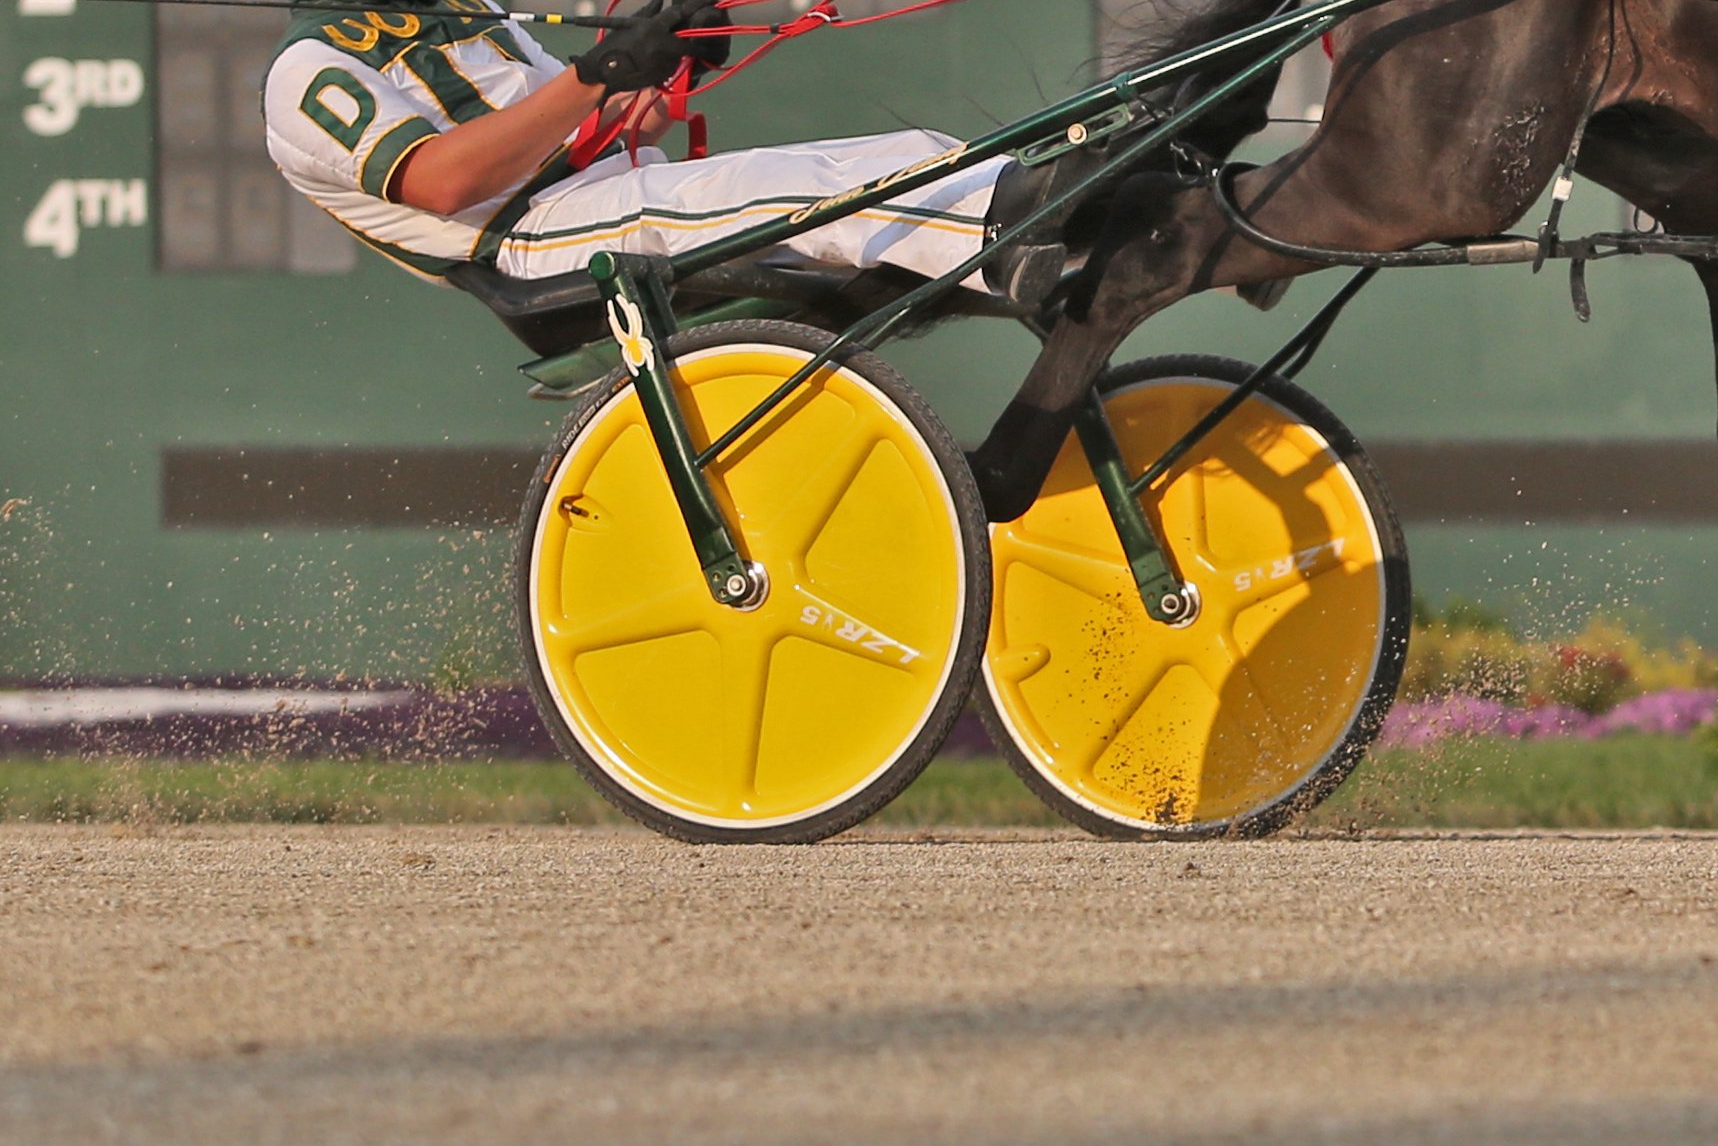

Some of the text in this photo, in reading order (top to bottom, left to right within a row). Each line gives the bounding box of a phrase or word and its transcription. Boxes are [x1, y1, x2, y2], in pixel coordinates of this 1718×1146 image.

[22, 57, 145, 136] 3RD
[298, 66, 377, 155] D
[24, 178, 148, 258] 4TH
